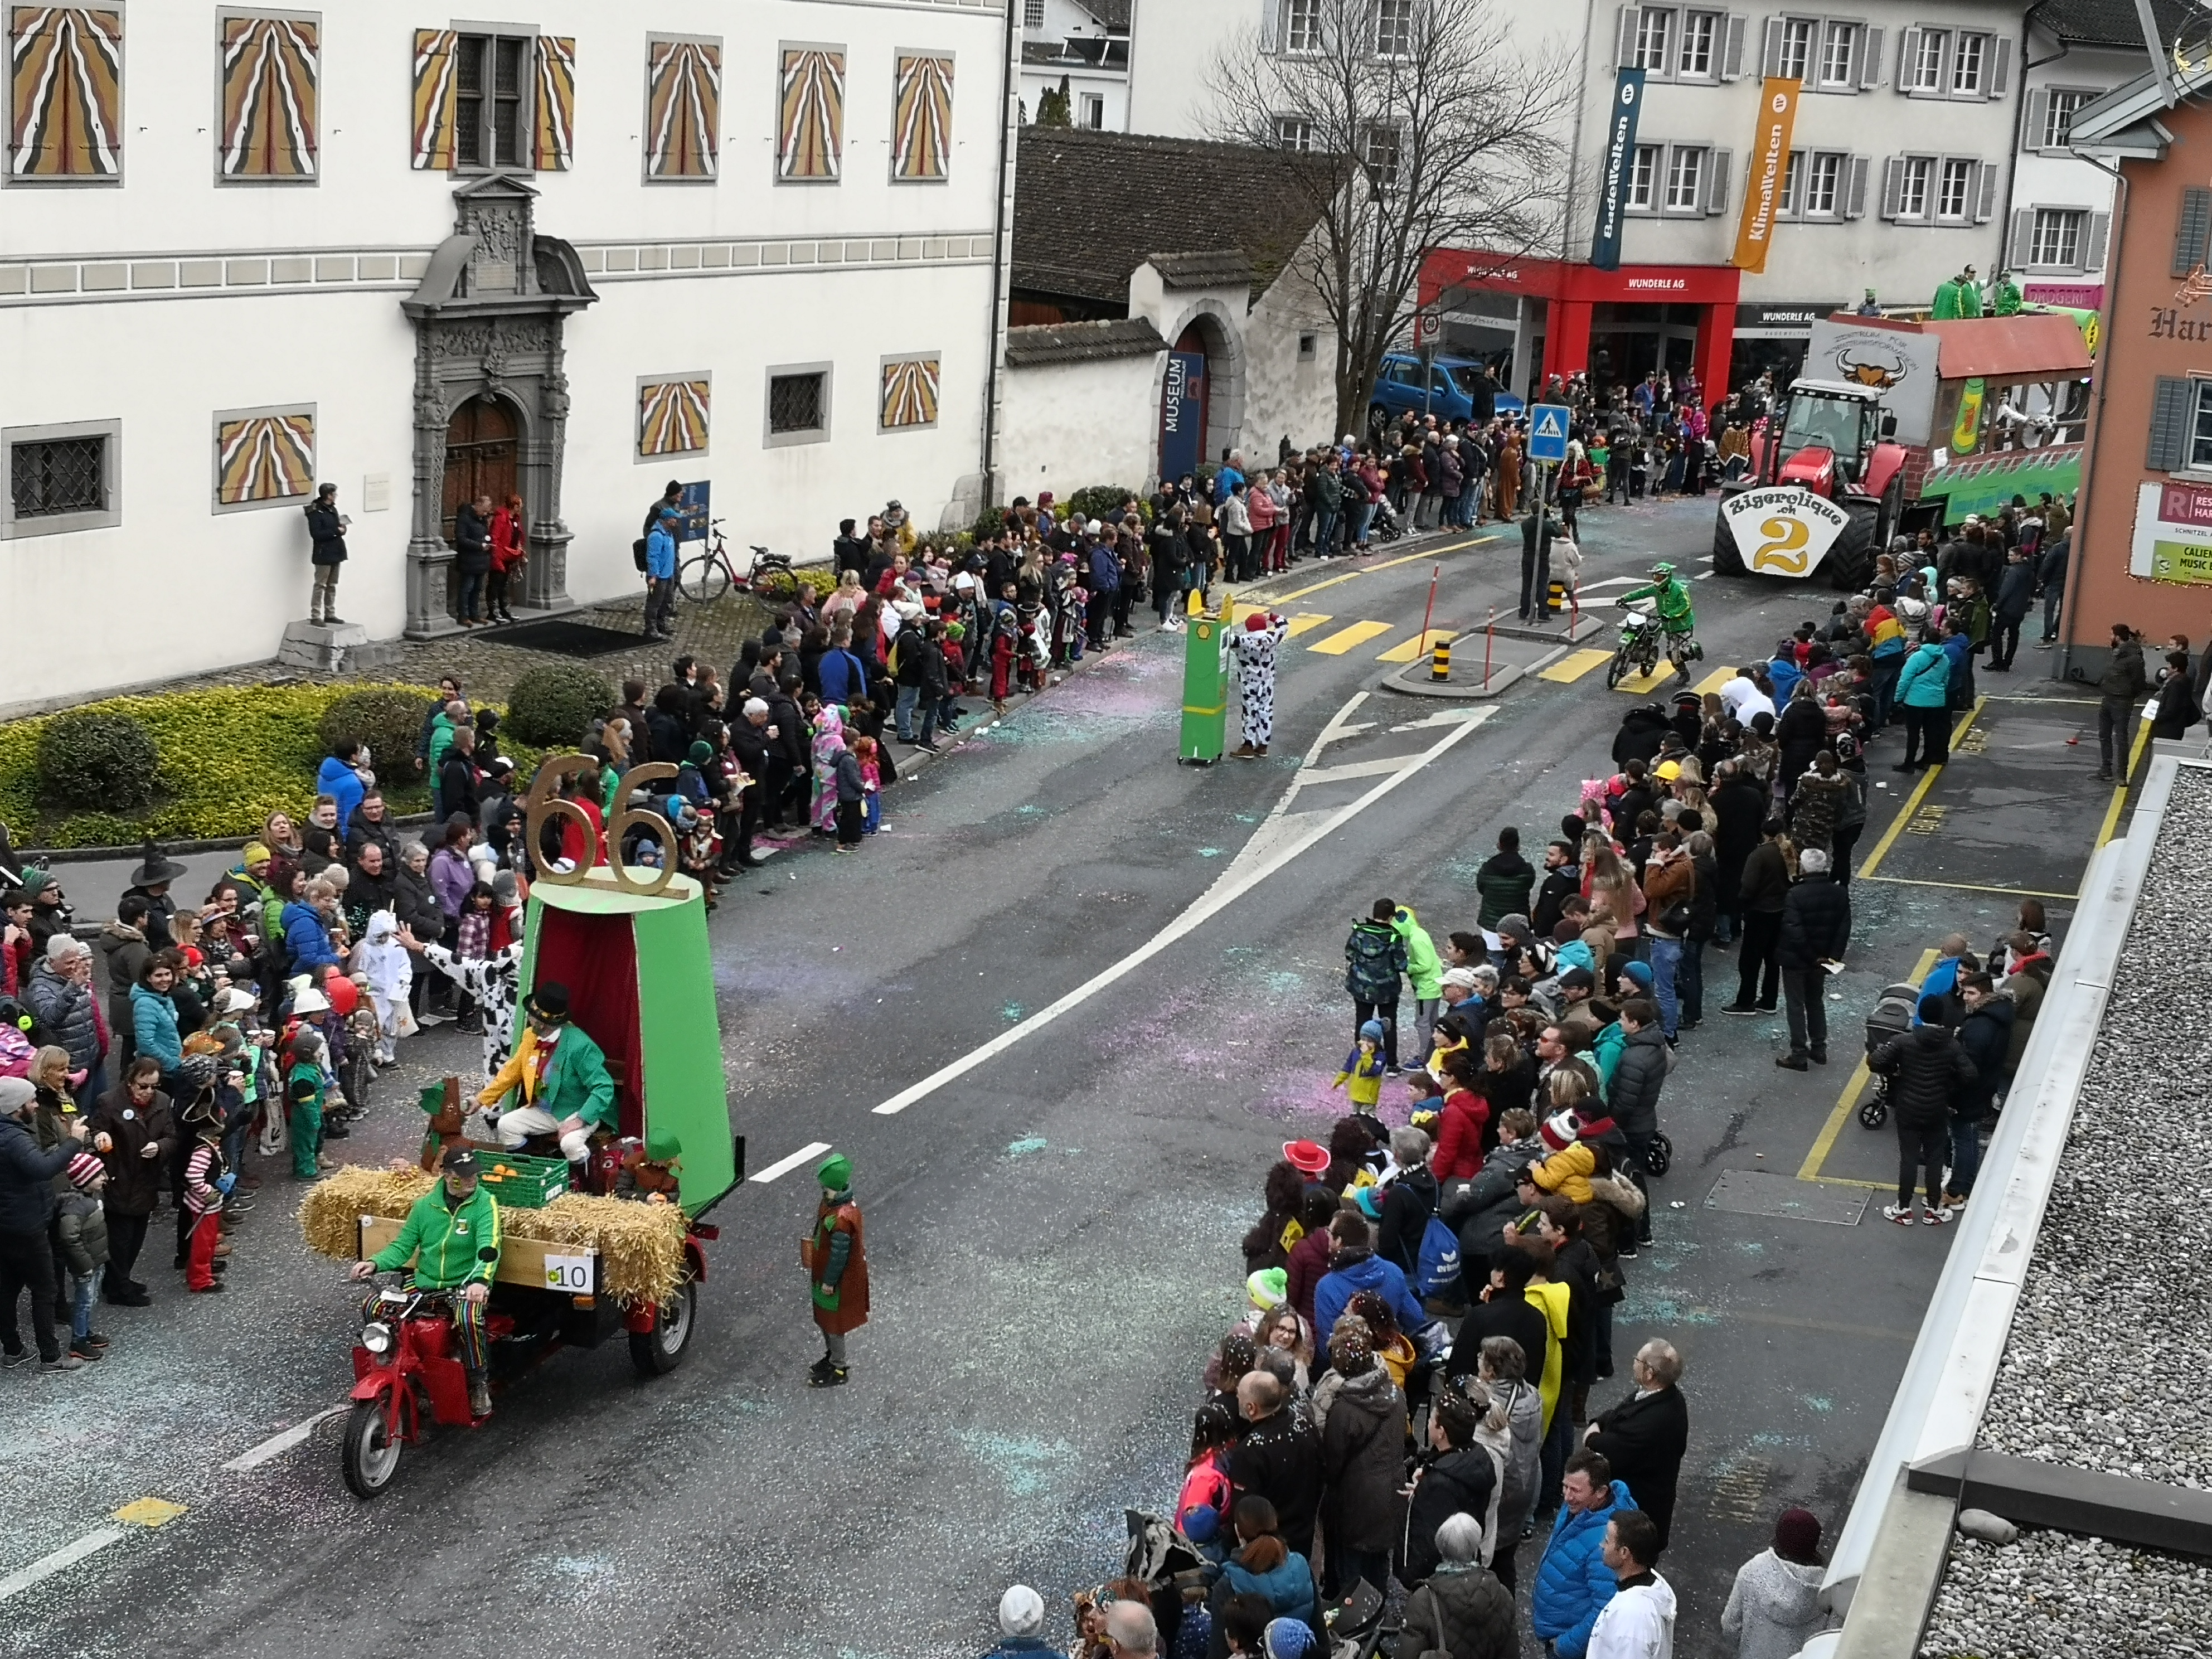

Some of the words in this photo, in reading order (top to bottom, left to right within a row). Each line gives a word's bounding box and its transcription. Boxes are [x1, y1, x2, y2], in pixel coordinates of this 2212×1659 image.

[1604, 117, 1628, 239] BadeWelten
[1748, 124, 1782, 240] KlimaWelten
[1629, 279, 1671, 288] WUNDERLE
[1673, 279, 1685, 289] AG
[1428, 319, 1435, 329] 30
[1763, 312, 1803, 322] WUNDERLE
[1804, 313, 1816, 322] AG
[2147, 307, 2212, 342] Har
[1165, 358, 1181, 433] MUSEUM
[1729, 492, 1842, 526] Zigerclique
[1777, 505, 1796, 515] .ch
[2196, 496, 2212, 507] RES
[2175, 527, 2208, 537] SCHNITZEL
[1753, 516, 1810, 573] 2
[2179, 558, 2207, 570] MUSIC
[526, 754, 680, 896] 66
[556, 1265, 586, 1288] 10
